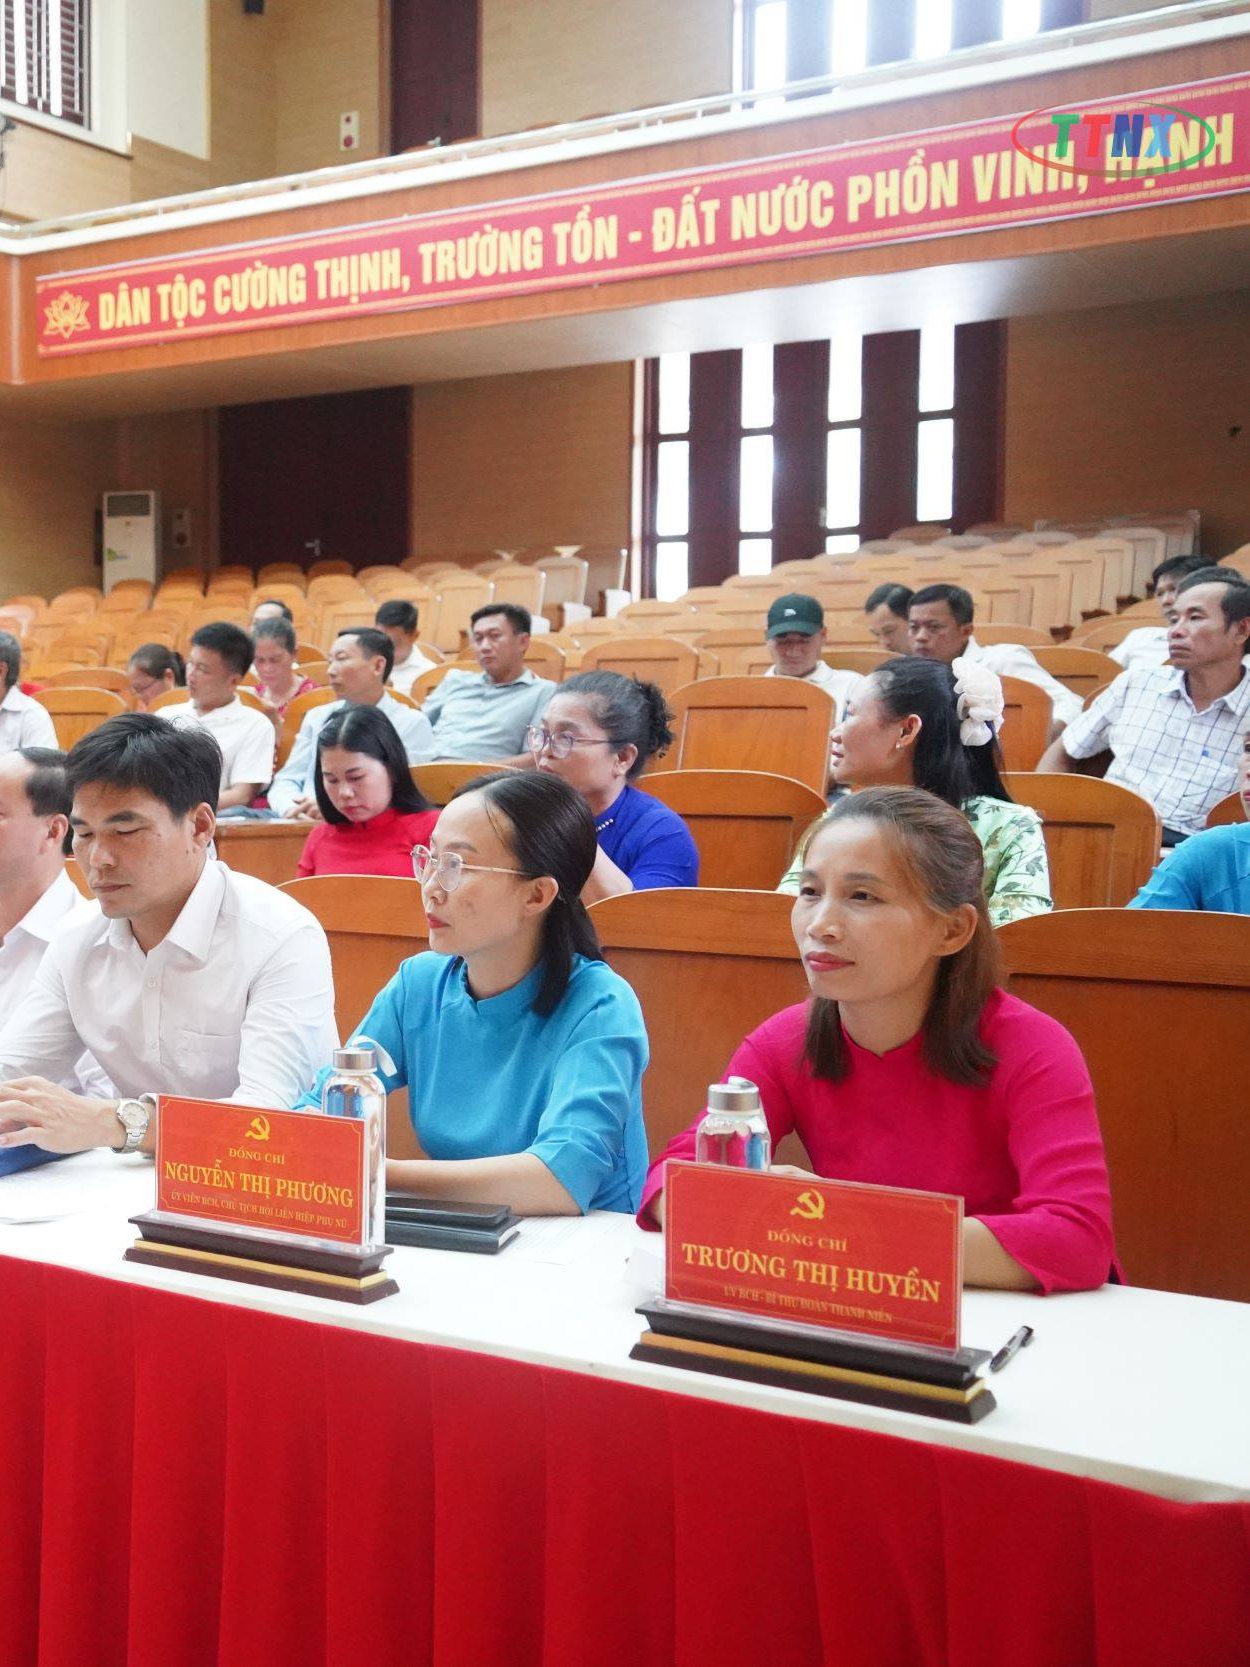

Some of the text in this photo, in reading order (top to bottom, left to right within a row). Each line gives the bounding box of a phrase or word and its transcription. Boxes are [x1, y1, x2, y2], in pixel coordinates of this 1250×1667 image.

[99, 282, 150, 331] DÂN
[157, 273, 206, 328] TỘC
[214, 260, 306, 315] CƯỜNG
[314, 248, 410, 304] THỊNH,
[418, 223, 543, 285] TRƯỜNG
[553, 204, 618, 266] TỒN
[652, 185, 720, 253] ĐẤT
[731, 175, 834, 241] NƯỚC
[847, 148, 959, 223] PHỒN
[972, 140, 1088, 203] VINH,
[1105, 113, 1234, 189] HẠNH
[229, 1145, 286, 1165] ĐỒNG CHÍ
[165, 1158, 354, 1208] NGUYỄN THỊ PHƯƠNG
[768, 1227, 848, 1252] ĐỒNG CHÍ
[682, 1243, 941, 1303] TRƯƠNG THỊ HUYỀN
